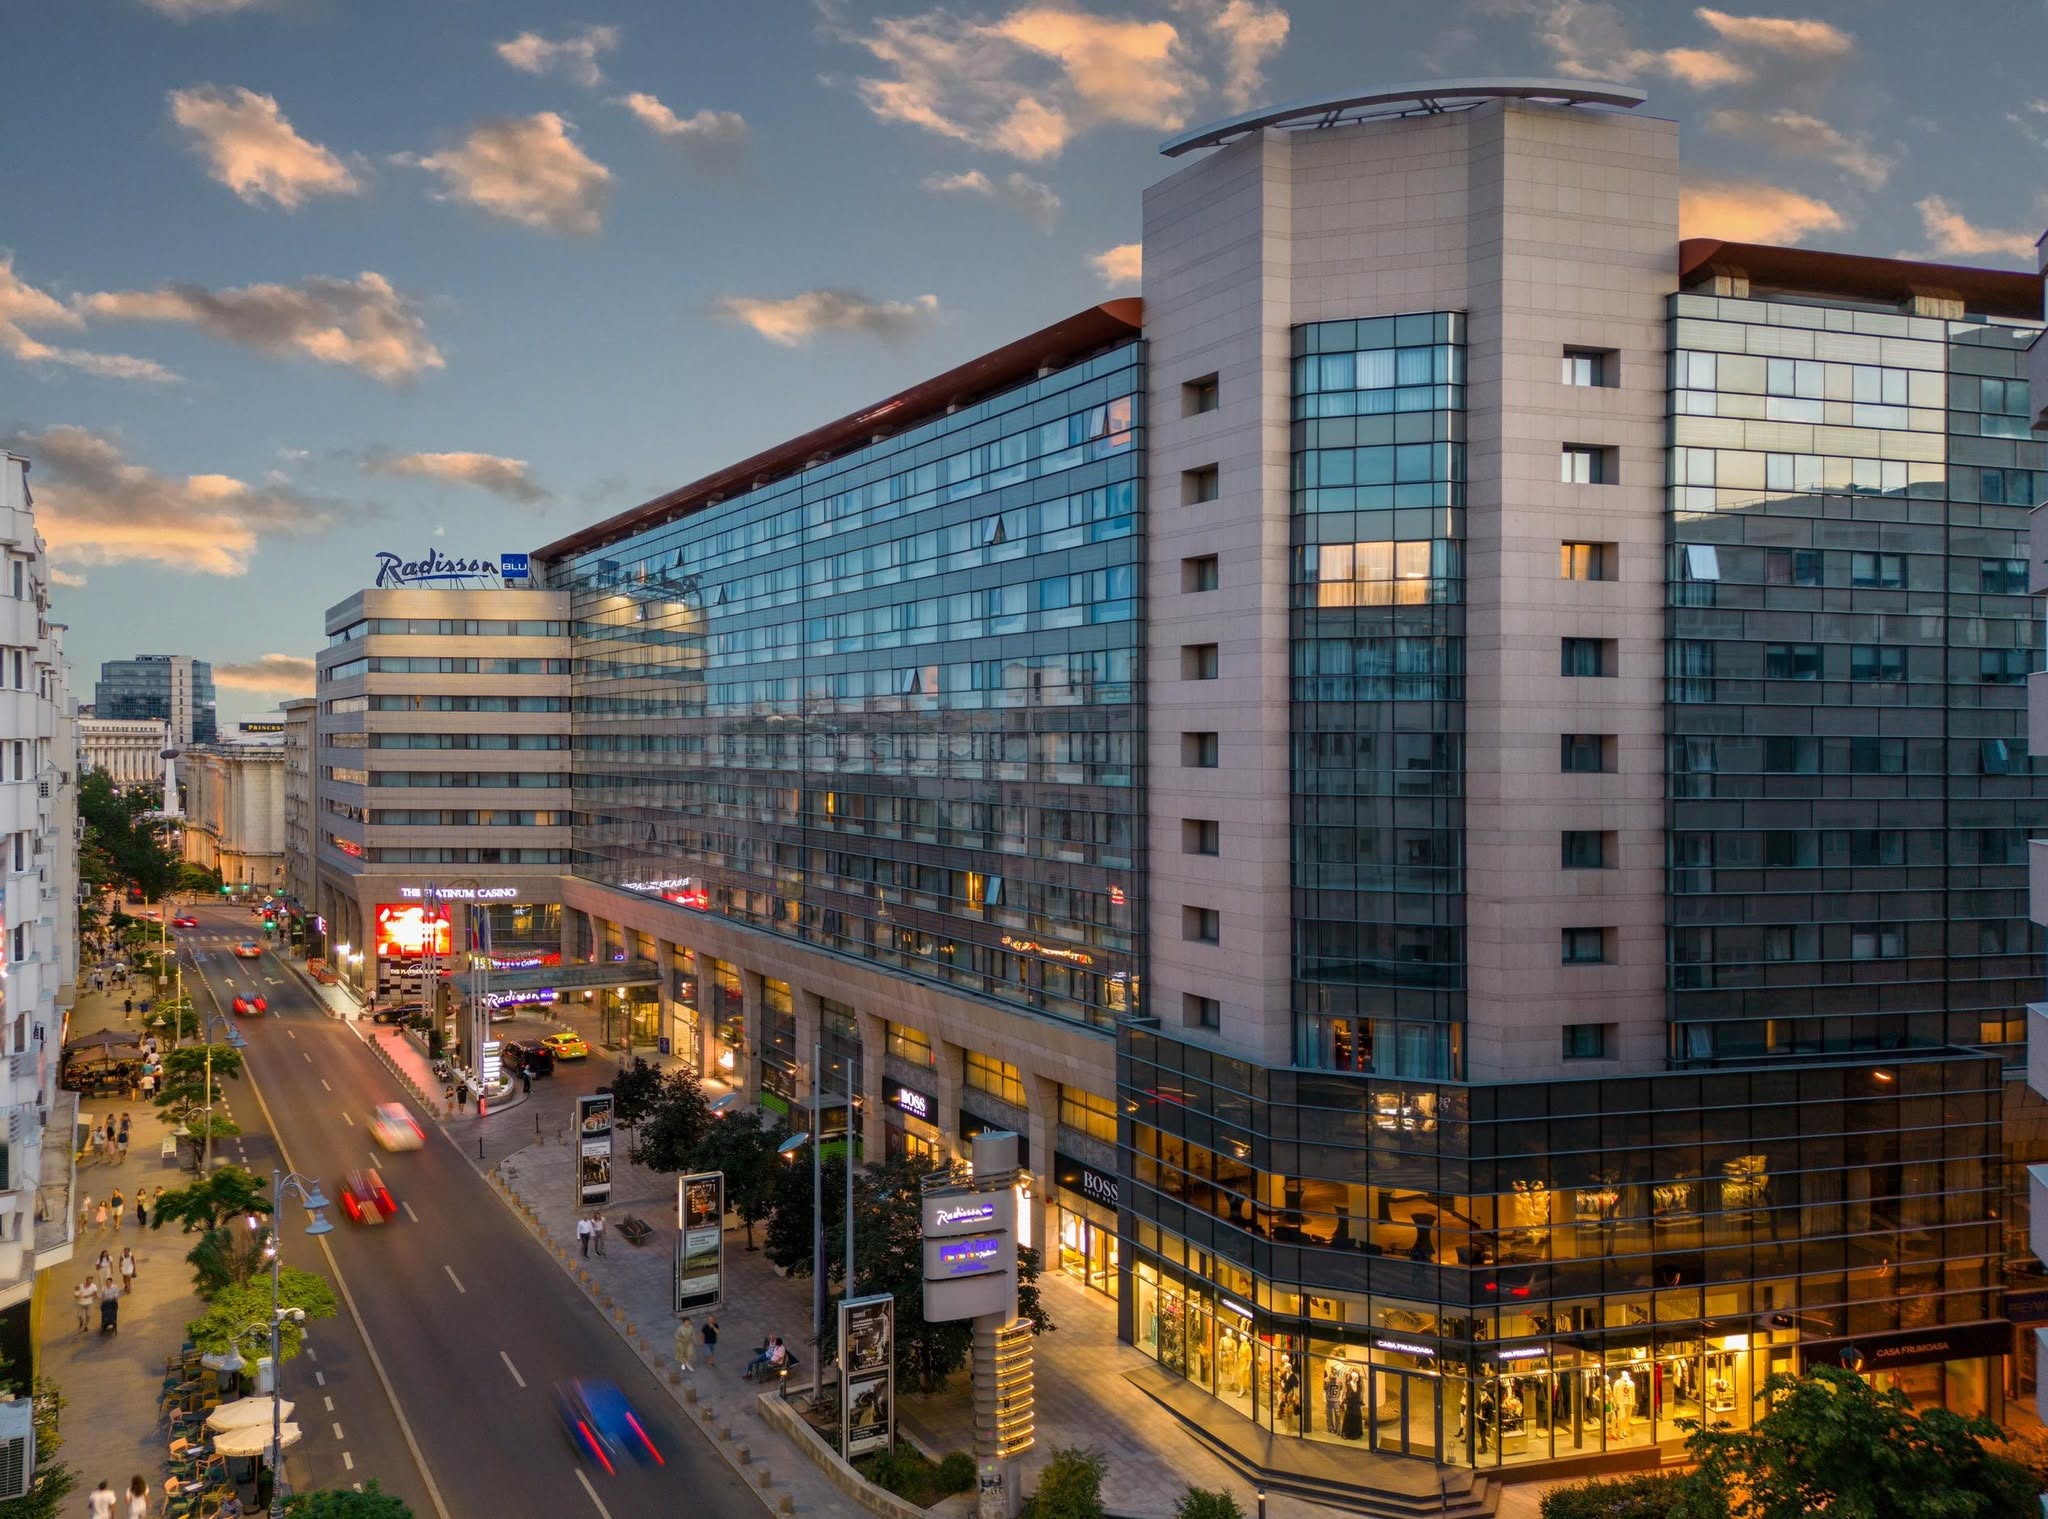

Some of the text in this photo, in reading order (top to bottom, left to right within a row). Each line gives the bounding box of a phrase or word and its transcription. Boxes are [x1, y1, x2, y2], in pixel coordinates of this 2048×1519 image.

[375, 547, 527, 587] Radisson BLU
[401, 888, 420, 897] THE
[477, 888, 517, 897] CASINO
[487, 990, 540, 1008] Radisson
[900, 1088, 926, 1112] BOSS
[1083, 1171, 1119, 1201] BOSS
[936, 1206, 983, 1226] Radisson
[1875, 1347, 1900, 1357] CASA
